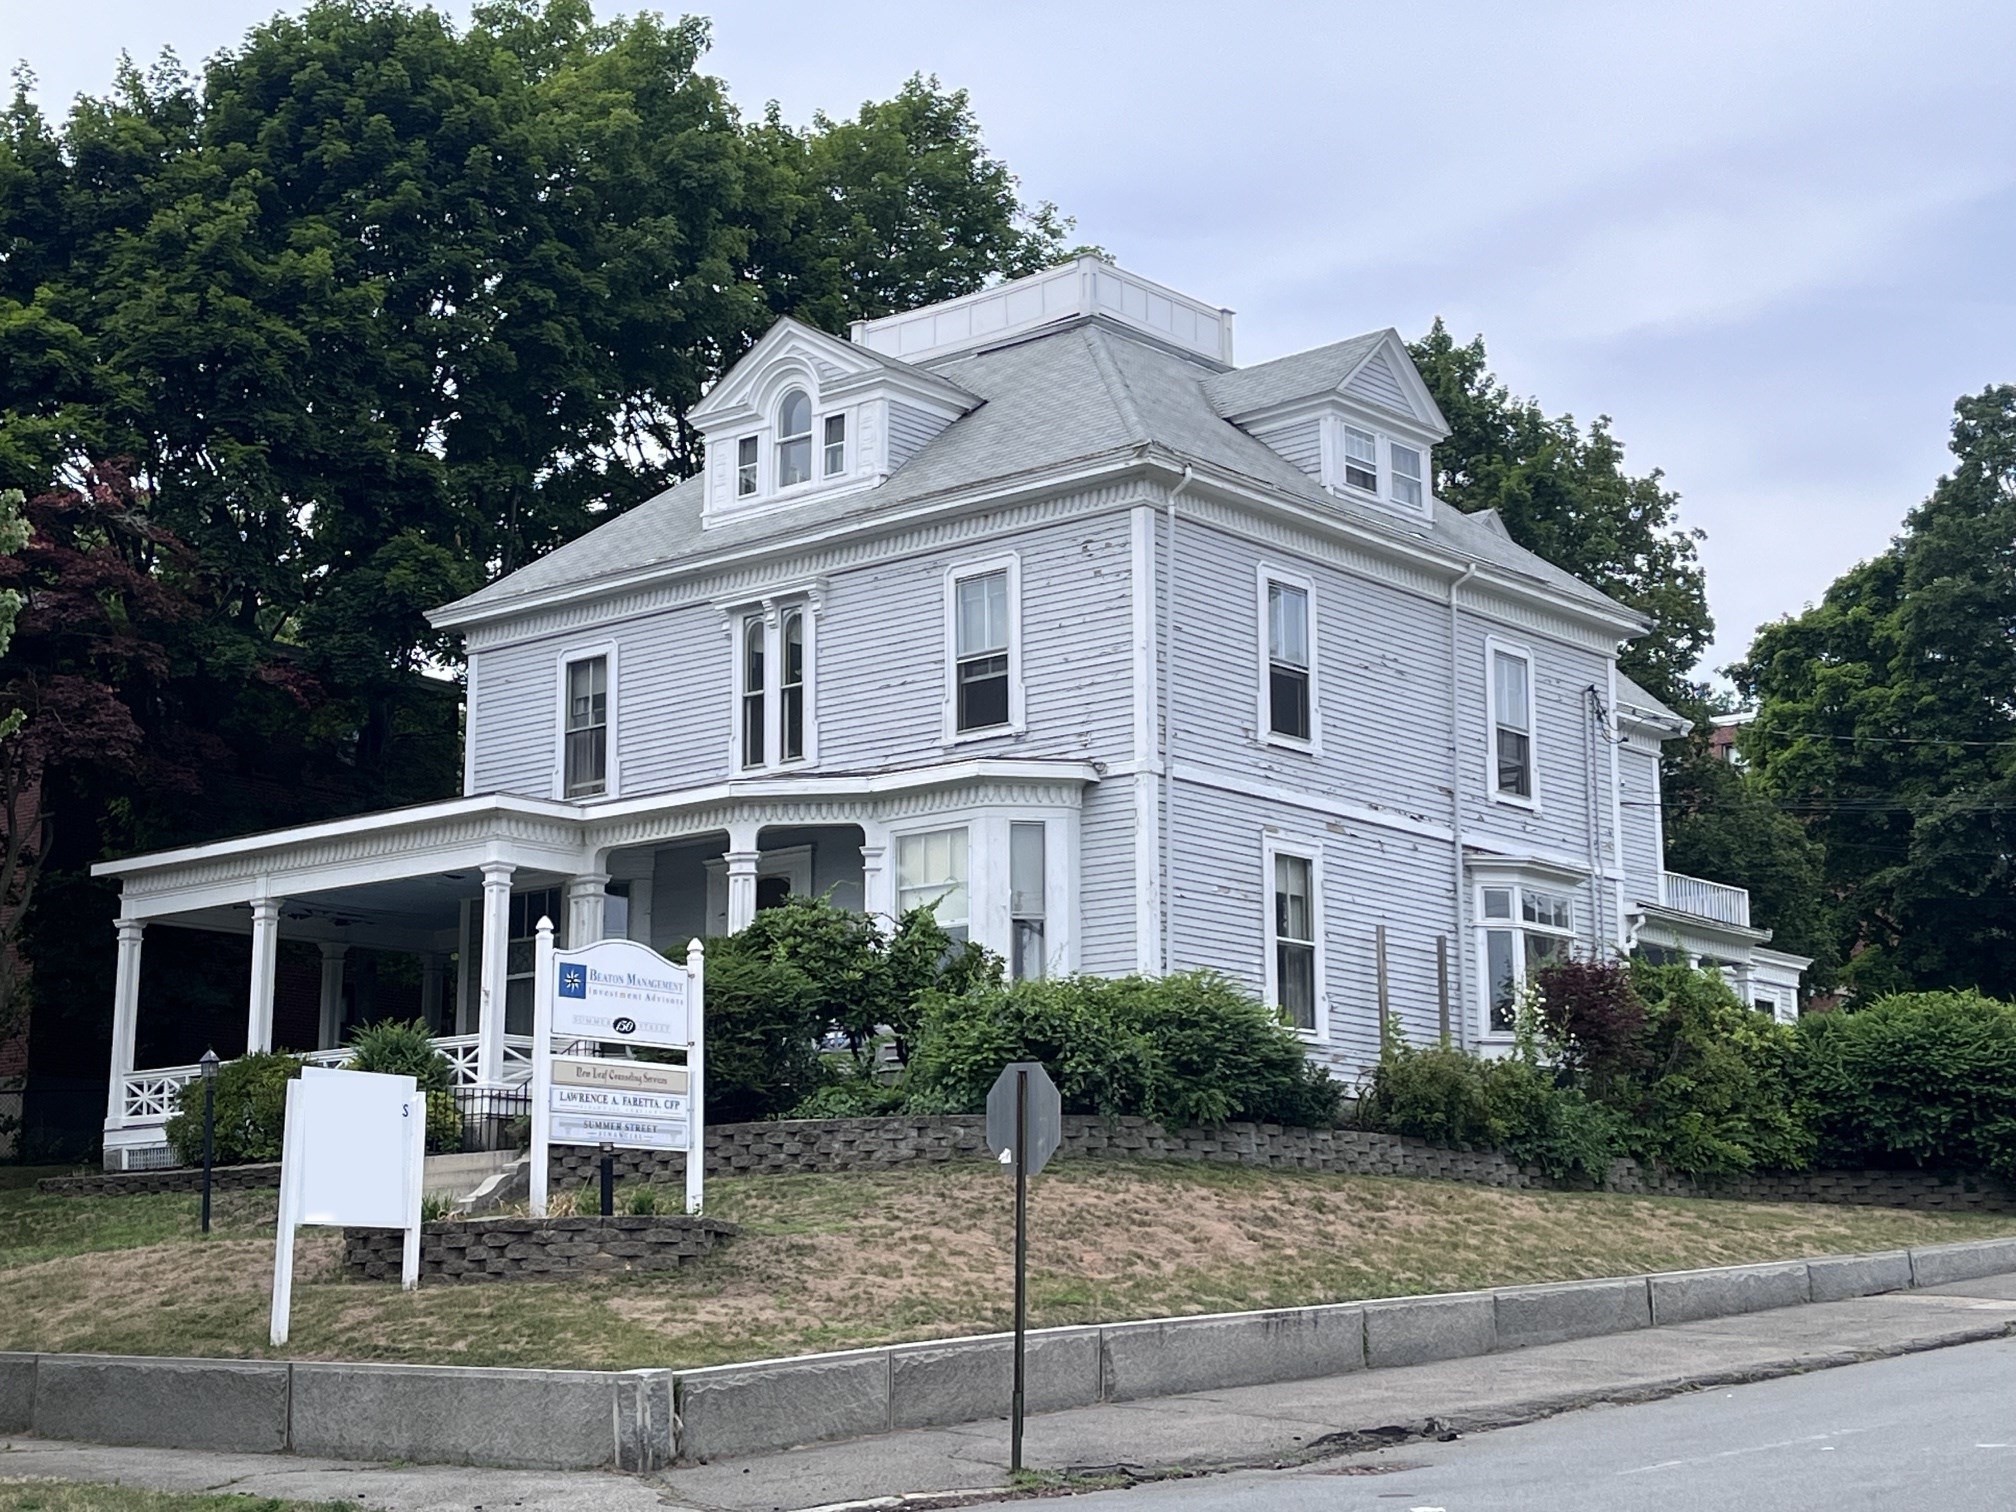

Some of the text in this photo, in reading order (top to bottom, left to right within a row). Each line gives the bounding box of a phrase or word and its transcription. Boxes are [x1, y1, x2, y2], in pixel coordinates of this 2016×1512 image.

[626, 973, 684, 993] MANAGEMENT
[588, 986, 684, 1006] Investment Advisors
[615, 1020, 634, 1032] 150
[592, 1067, 608, 1084] Leaf
[559, 1091, 609, 1105] LAWRENCE
[611, 1095, 620, 1105] A.
[664, 1100, 681, 1110] CFP
[583, 1120, 659, 1133] SUMMER STREET
